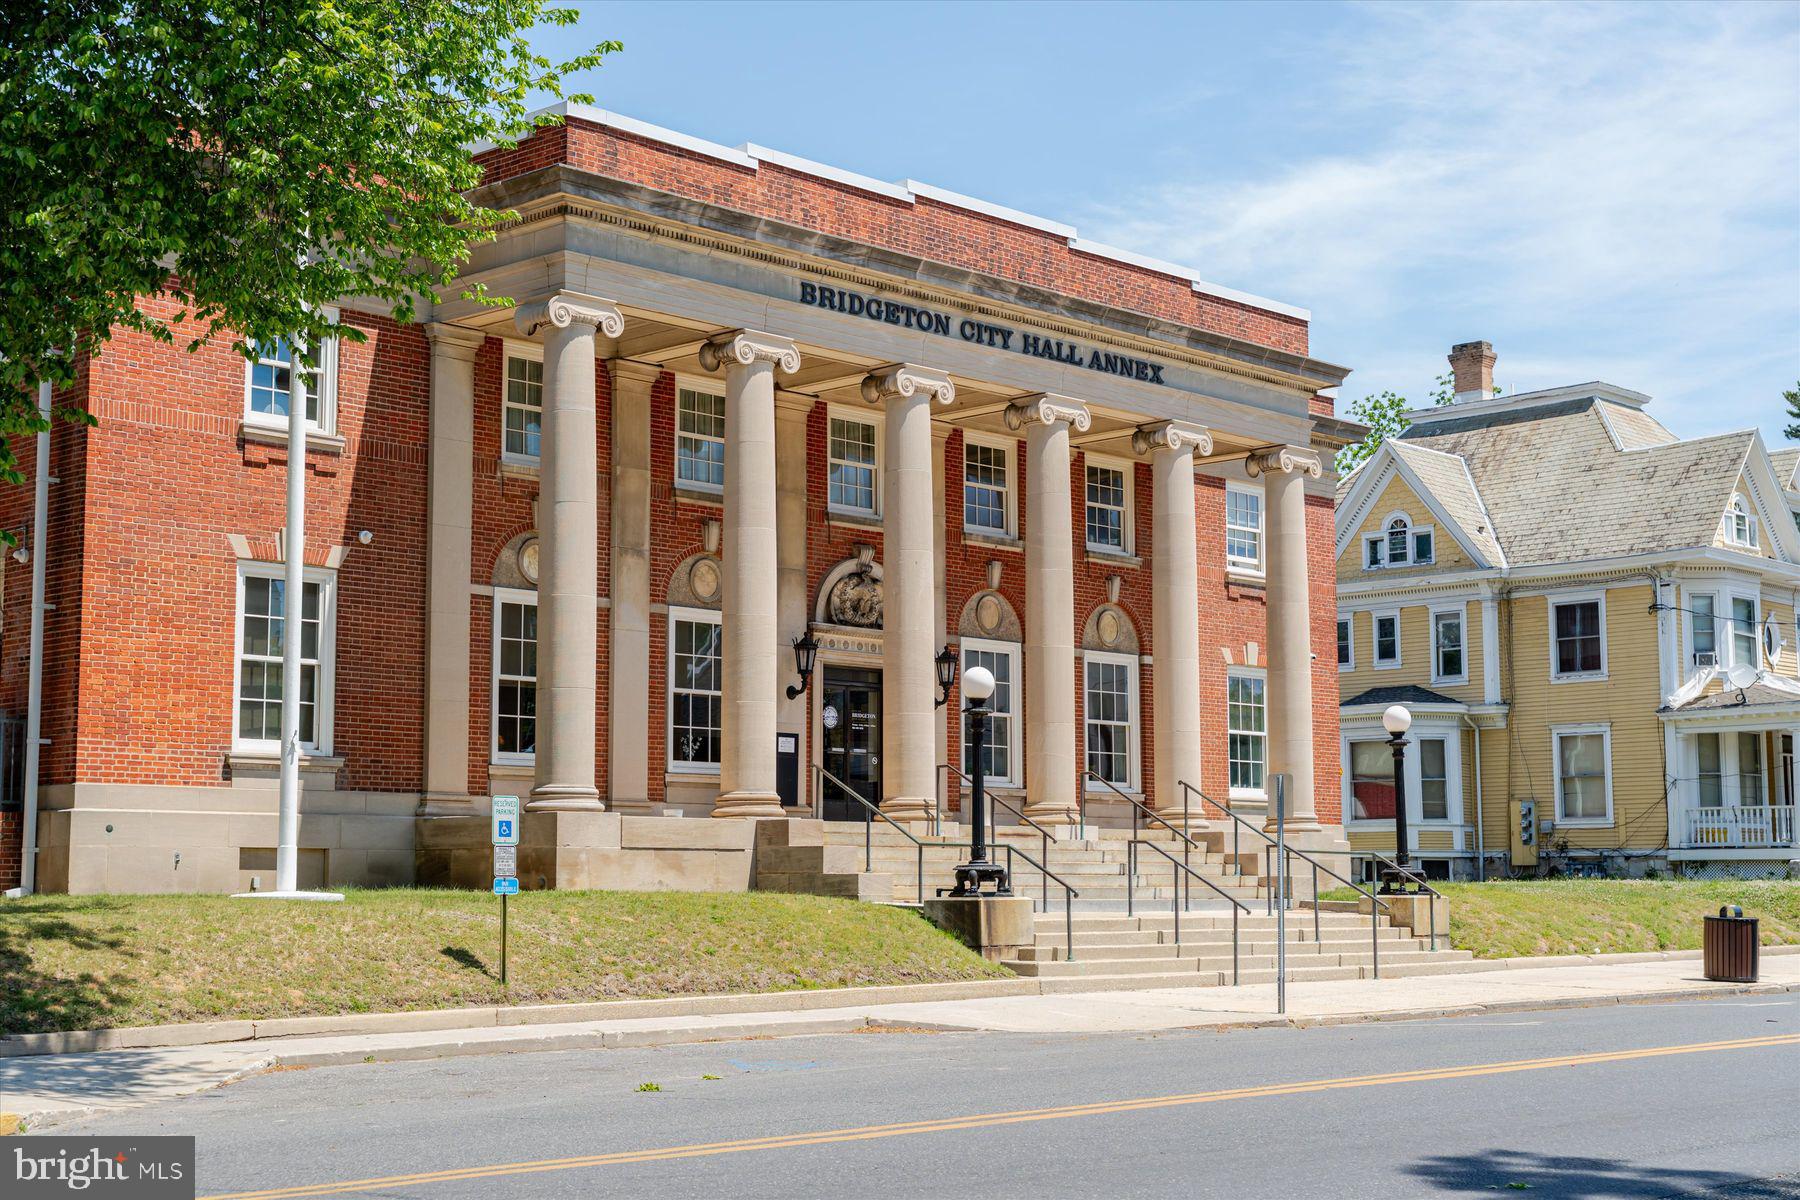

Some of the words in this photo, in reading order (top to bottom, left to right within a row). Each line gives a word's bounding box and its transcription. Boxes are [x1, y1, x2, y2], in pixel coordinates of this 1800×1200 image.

[800, 281, 951, 336] BRIDGETON
[960, 319, 1013, 349] CITY
[1022, 333, 1084, 367] HALL
[1088, 350, 1165, 385] ANNEX
[494, 800, 516, 808] RESERVED
